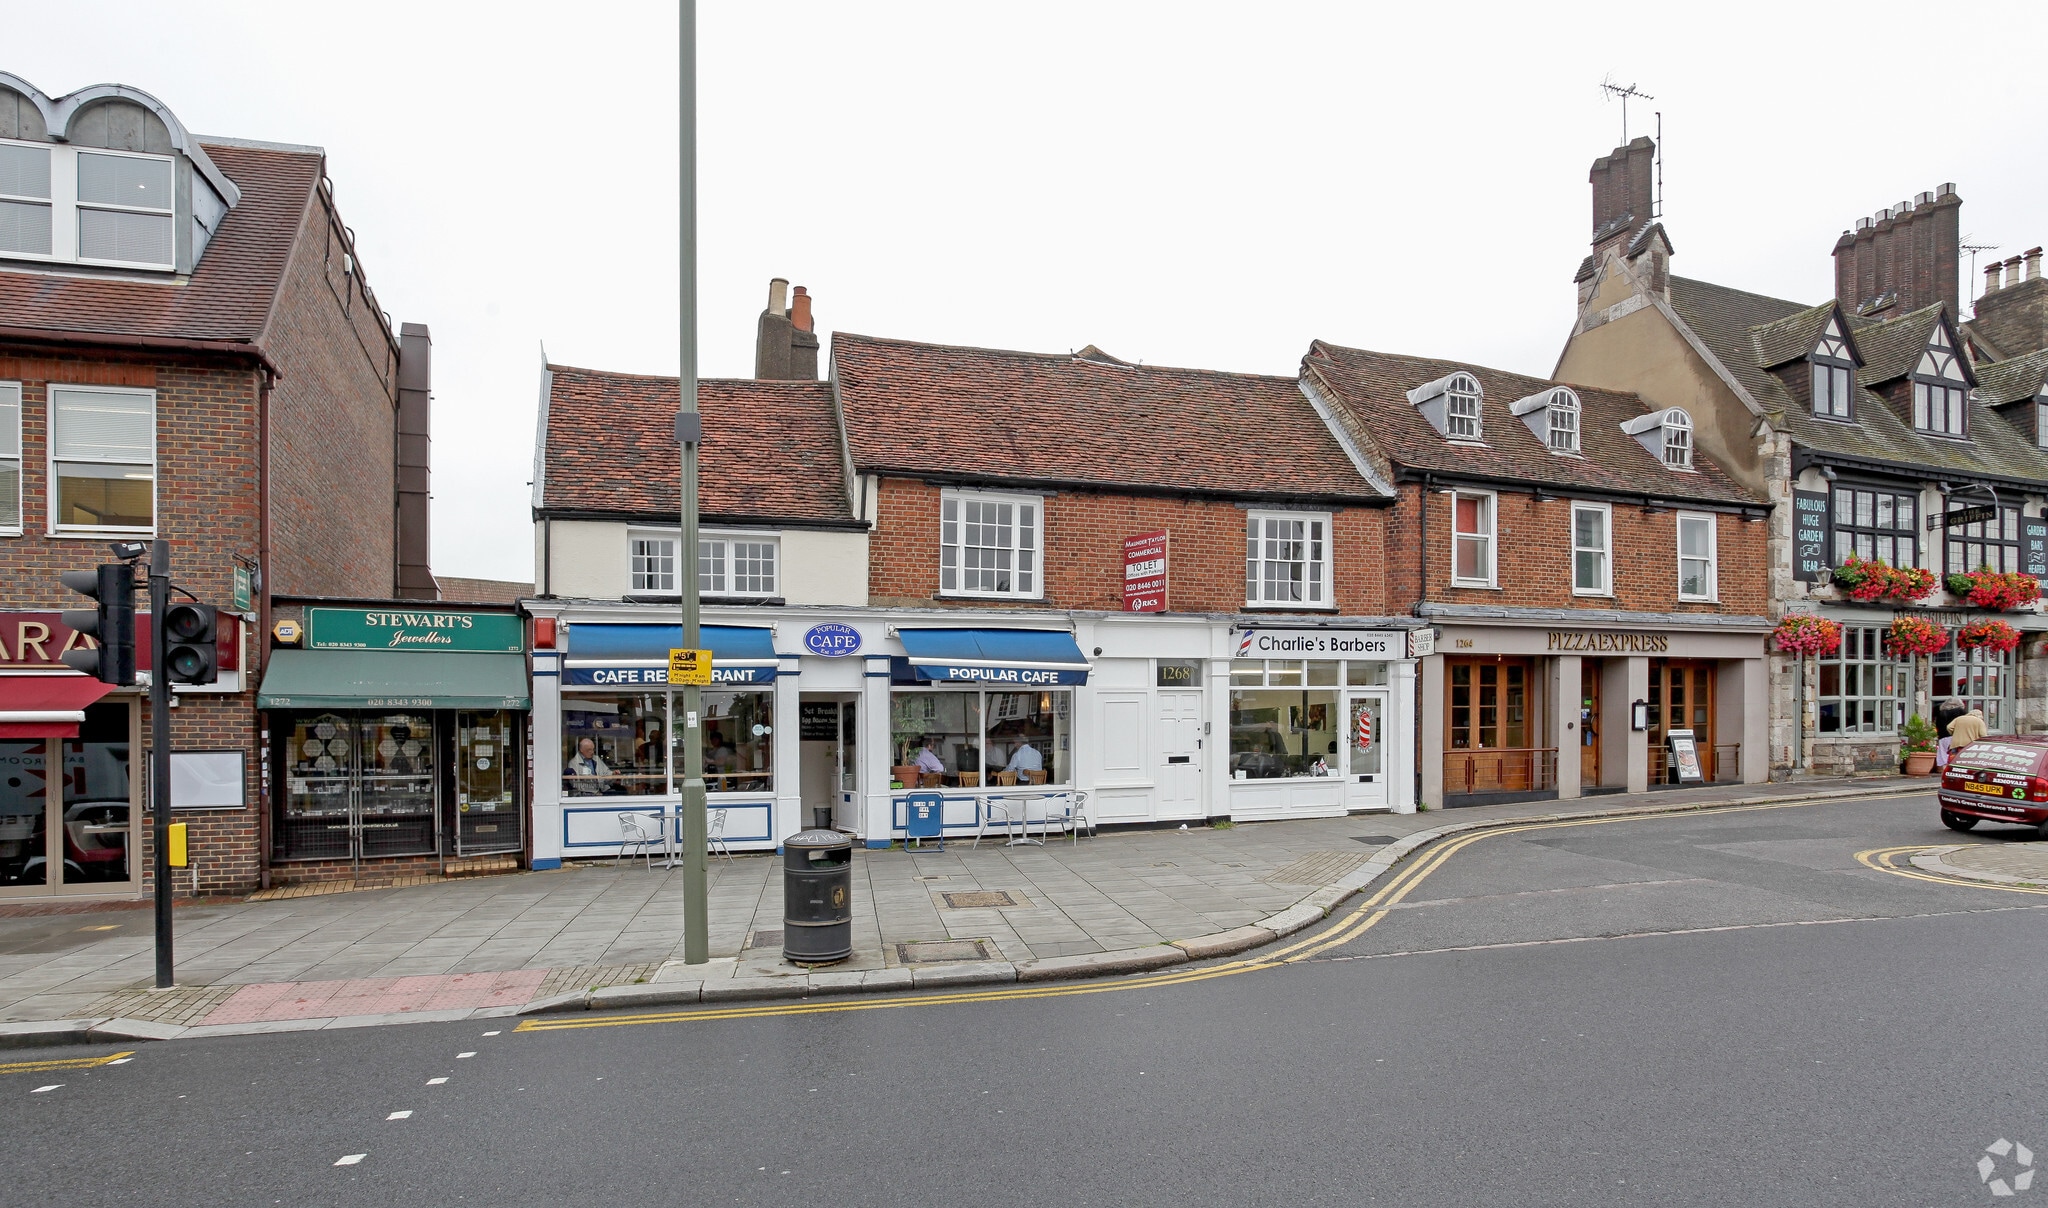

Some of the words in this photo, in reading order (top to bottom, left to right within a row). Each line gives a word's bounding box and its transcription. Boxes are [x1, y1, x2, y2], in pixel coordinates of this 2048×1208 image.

[1796, 498, 1826, 513] FABULOUS
[1802, 514, 1819, 526] HUGE
[1949, 511, 1993, 524] GRIFFIN
[1798, 529, 1824, 542] GARDEN
[2026, 525, 2047, 536] GARDEN
[2030, 540, 2043, 551] BARS
[1128, 547, 1162, 558] COMMERCIAL
[1132, 563, 1142, 572] TO
[1143, 560, 1157, 570] LET
[1802, 560, 1818, 572] REAR
[1151, 579, 1165, 587] 0011
[1142, 599, 1158, 607] RICS
[366, 613, 473, 629] STEWART'S
[815, 625, 851, 634] POPULAR
[388, 630, 452, 647] Jewellers
[810, 635, 856, 648] CAFE
[1258, 636, 1325, 651] Charlie's
[1330, 637, 1386, 652] Barbers
[1414, 633, 1433, 643] BARBER
[1547, 632, 1668, 651] PIZZAEXPRESS
[1418, 643, 1429, 652] SHOP
[593, 670, 639, 683] CAFE
[643, 669, 756, 683] RERANT
[949, 668, 1017, 681] POPULAR
[1021, 670, 1058, 683] CAFE
[270, 698, 291, 706] 1272
[367, 698, 384, 706] 020
[387, 698, 408, 706] 8343
[411, 699, 432, 707] 9300
[502, 699, 520, 707] 1272
[1992, 745, 2037, 758] Gone
[1956, 760, 2028, 772] www.allgone.co.uk
[1992, 778, 2028, 787] REMOVALS
[1985, 785, 2002, 794] UPK
[1941, 795, 1961, 804] London's
[1961, 799, 1977, 807] Green
[1977, 802, 2007, 811] Clearance
